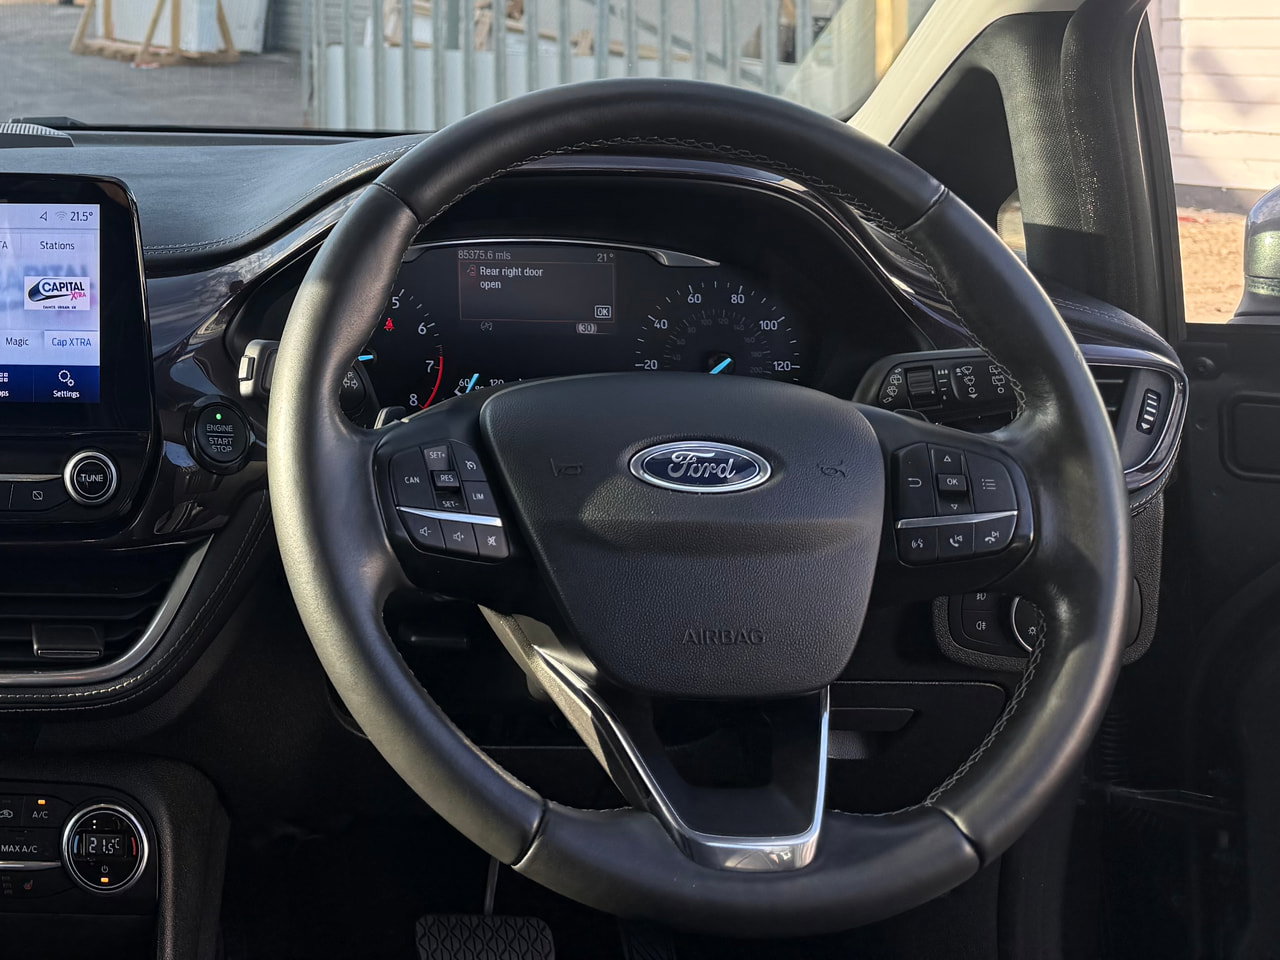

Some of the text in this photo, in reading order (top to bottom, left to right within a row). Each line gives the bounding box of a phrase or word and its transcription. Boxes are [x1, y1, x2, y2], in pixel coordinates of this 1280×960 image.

[70, 211, 93, 222] 21.5°
[40, 240, 75, 250] Stations
[458, 250, 493, 259] 85375.6
[480, 266, 544, 278] Rear right door
[42, 281, 85, 293] CAPITAL
[480, 280, 501, 290] open
[70, 291, 87, 301] XTRA
[687, 293, 745, 304] 60 80
[392, 296, 400, 309] 5
[597, 308, 609, 316] OK
[418, 322, 426, 335] 6
[654, 319, 668, 330] 40
[759, 320, 778, 331] 100
[5, 337, 29, 347] Magic
[51, 338, 91, 348] Cap XTRA
[425, 360, 434, 373] 7
[644, 359, 658, 370] 20
[773, 361, 791, 371] 120
[53, 390, 80, 399] Settings
[409, 393, 418, 406] 8
[206, 424, 233, 432] ENGINE
[209, 437, 233, 445] START
[211, 445, 232, 453] STOP
[667, 451, 736, 479] Ford
[80, 473, 103, 482] TUNE
[404, 476, 420, 484] CAN
[440, 474, 453, 482] RES
[946, 477, 958, 486] OK
[682, 628, 766, 645] AIRBAG
[32, 810, 49, 819] A/C
[0, 844, 38, 853] MAX A/C
